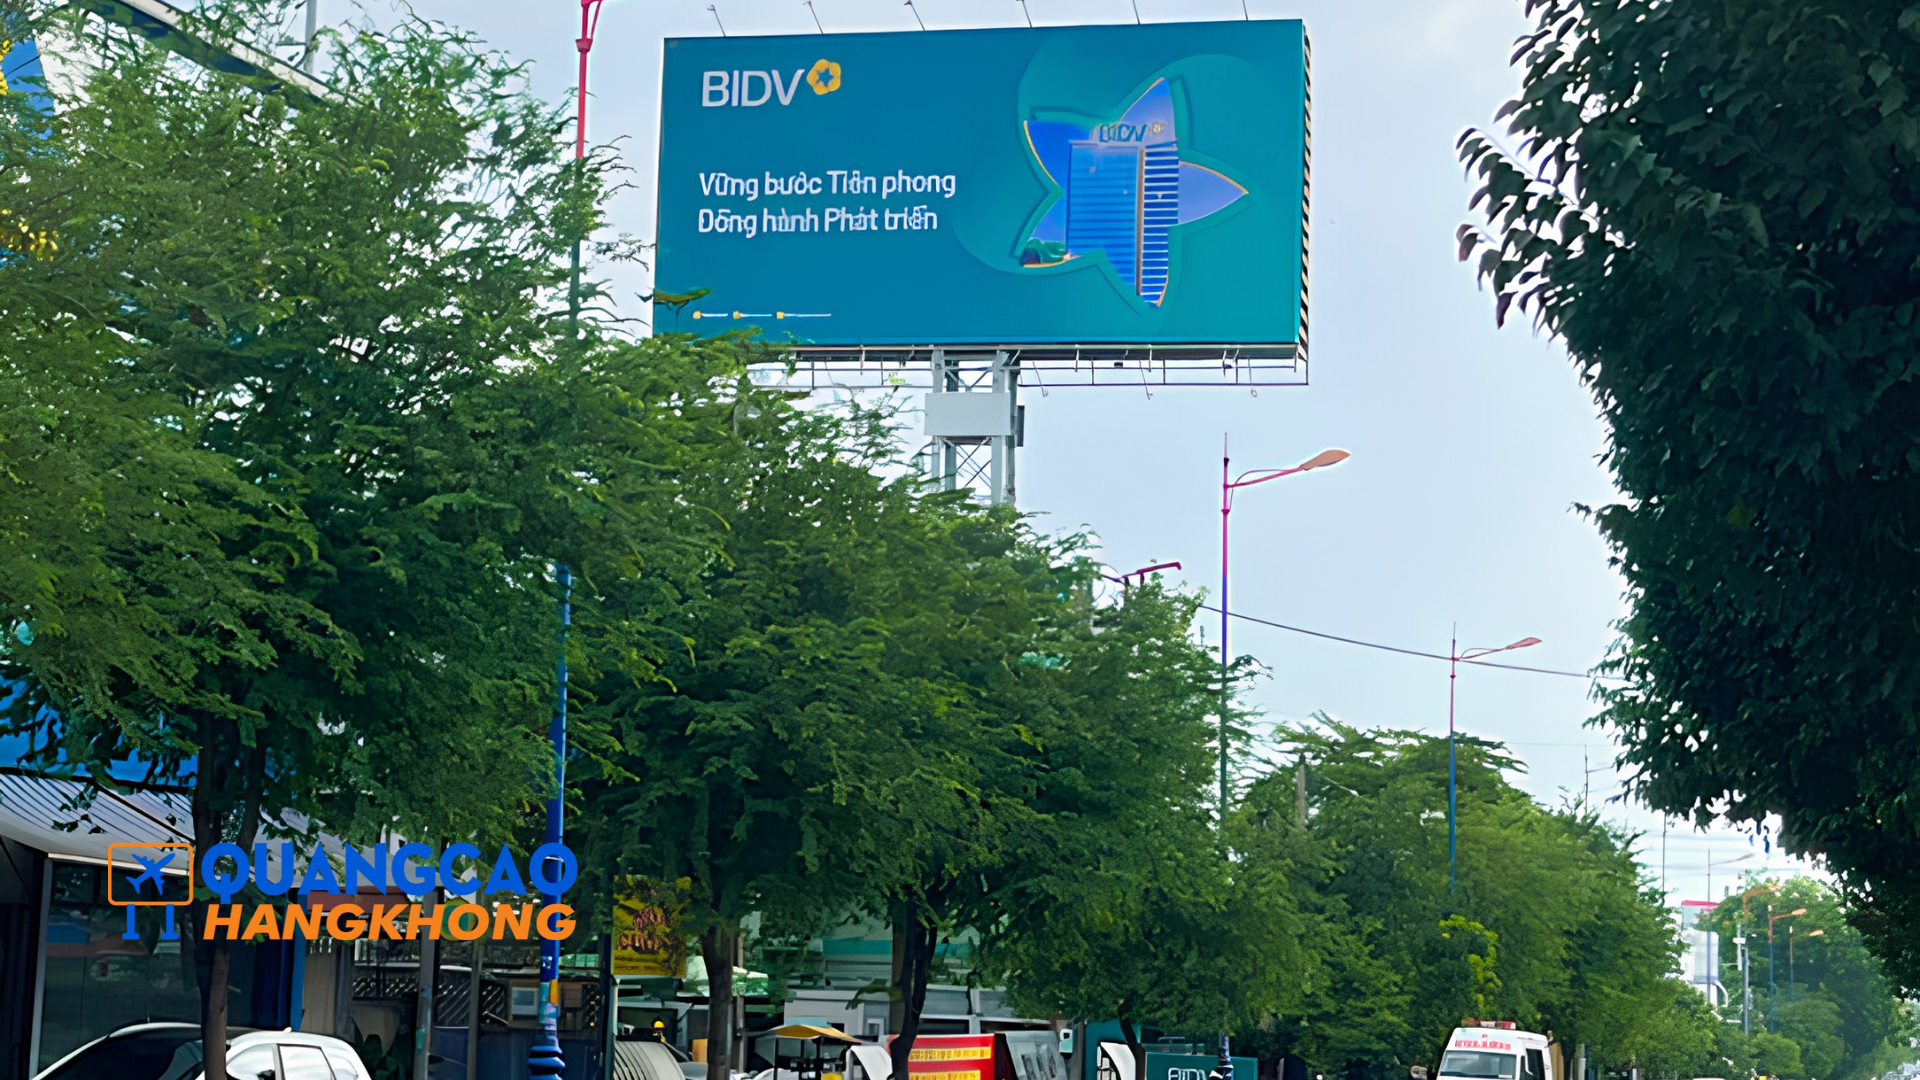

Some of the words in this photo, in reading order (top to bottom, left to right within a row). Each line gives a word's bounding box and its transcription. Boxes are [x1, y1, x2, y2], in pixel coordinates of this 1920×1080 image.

[701, 69, 805, 107] BIDV
[882, 169, 956, 199] phong
[762, 207, 819, 232] hành
[824, 206, 879, 232] Phát
